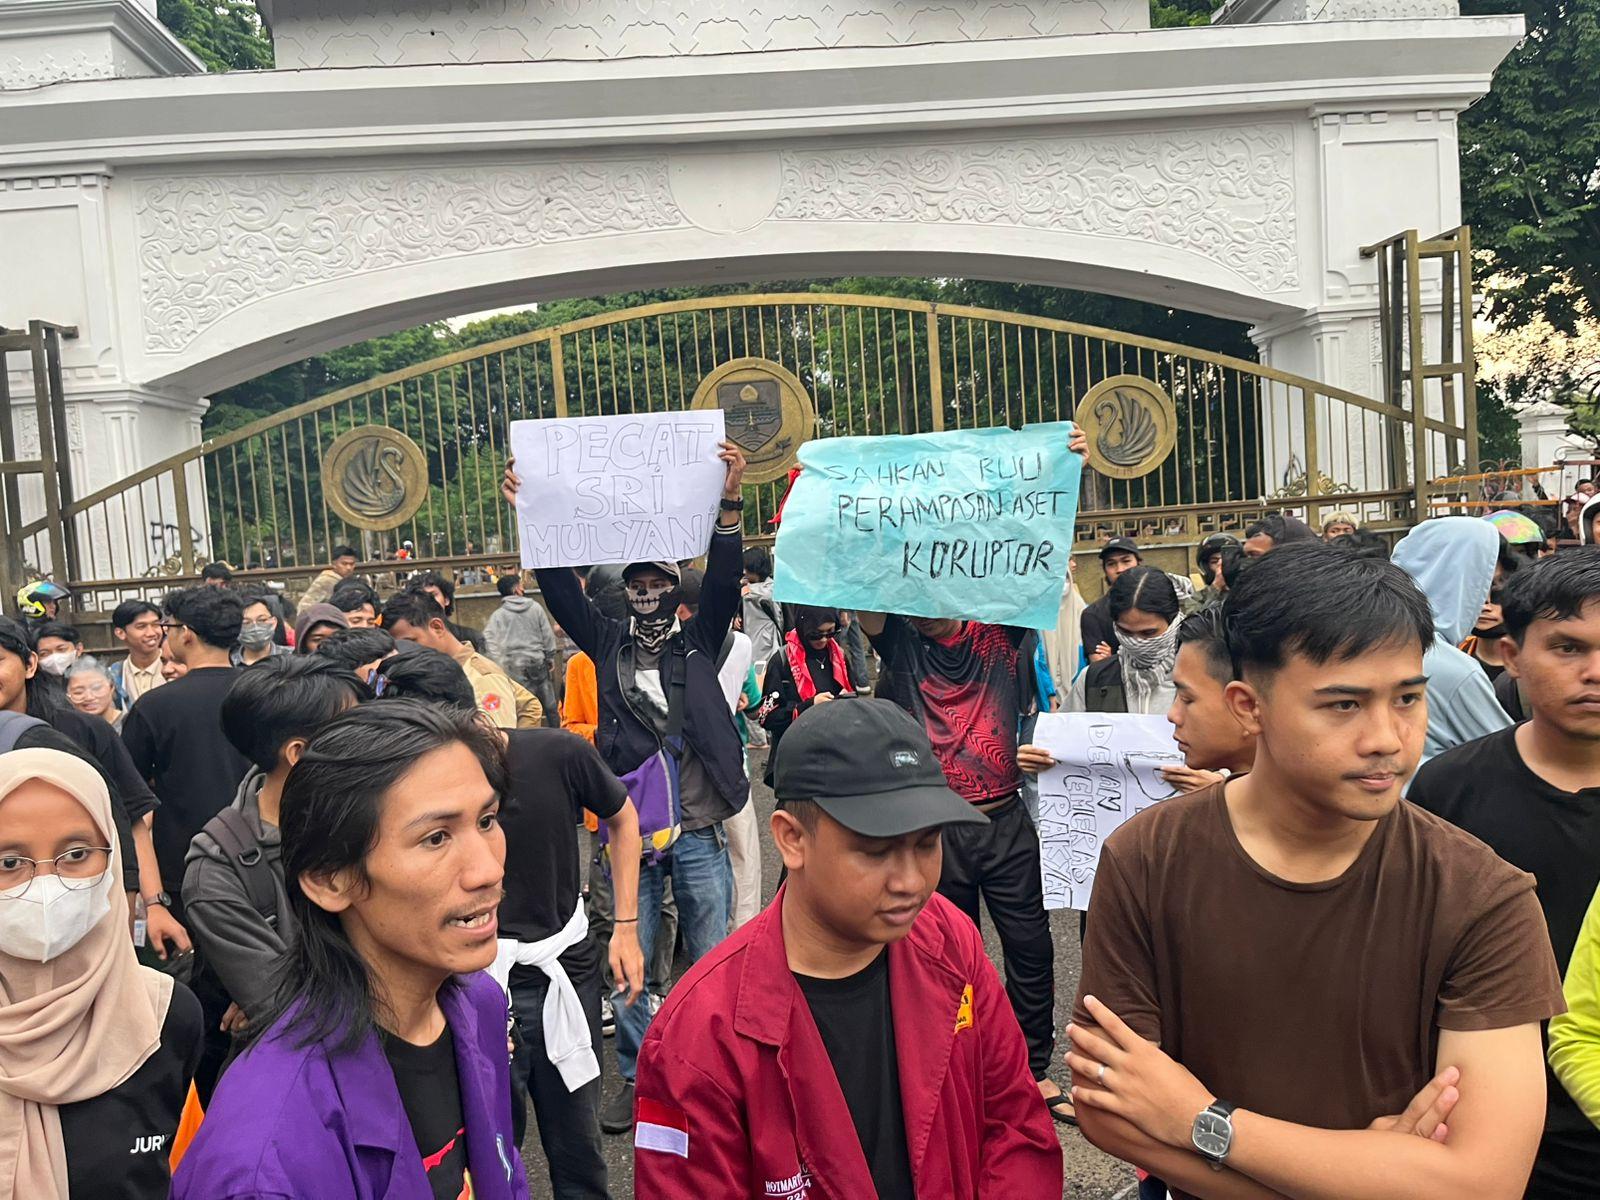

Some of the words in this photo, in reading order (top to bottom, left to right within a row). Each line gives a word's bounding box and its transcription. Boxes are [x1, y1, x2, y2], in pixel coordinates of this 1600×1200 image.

[543, 422, 714, 476] PECAT
[824, 458, 945, 486] SAHKAN
[979, 452, 1042, 481] RUU
[838, 491, 1004, 532] PERAMPASAN
[1012, 491, 1069, 520] ASET
[902, 538, 1055, 579] KORUPTOR
[1038, 794, 1073, 909] RAKYAT
